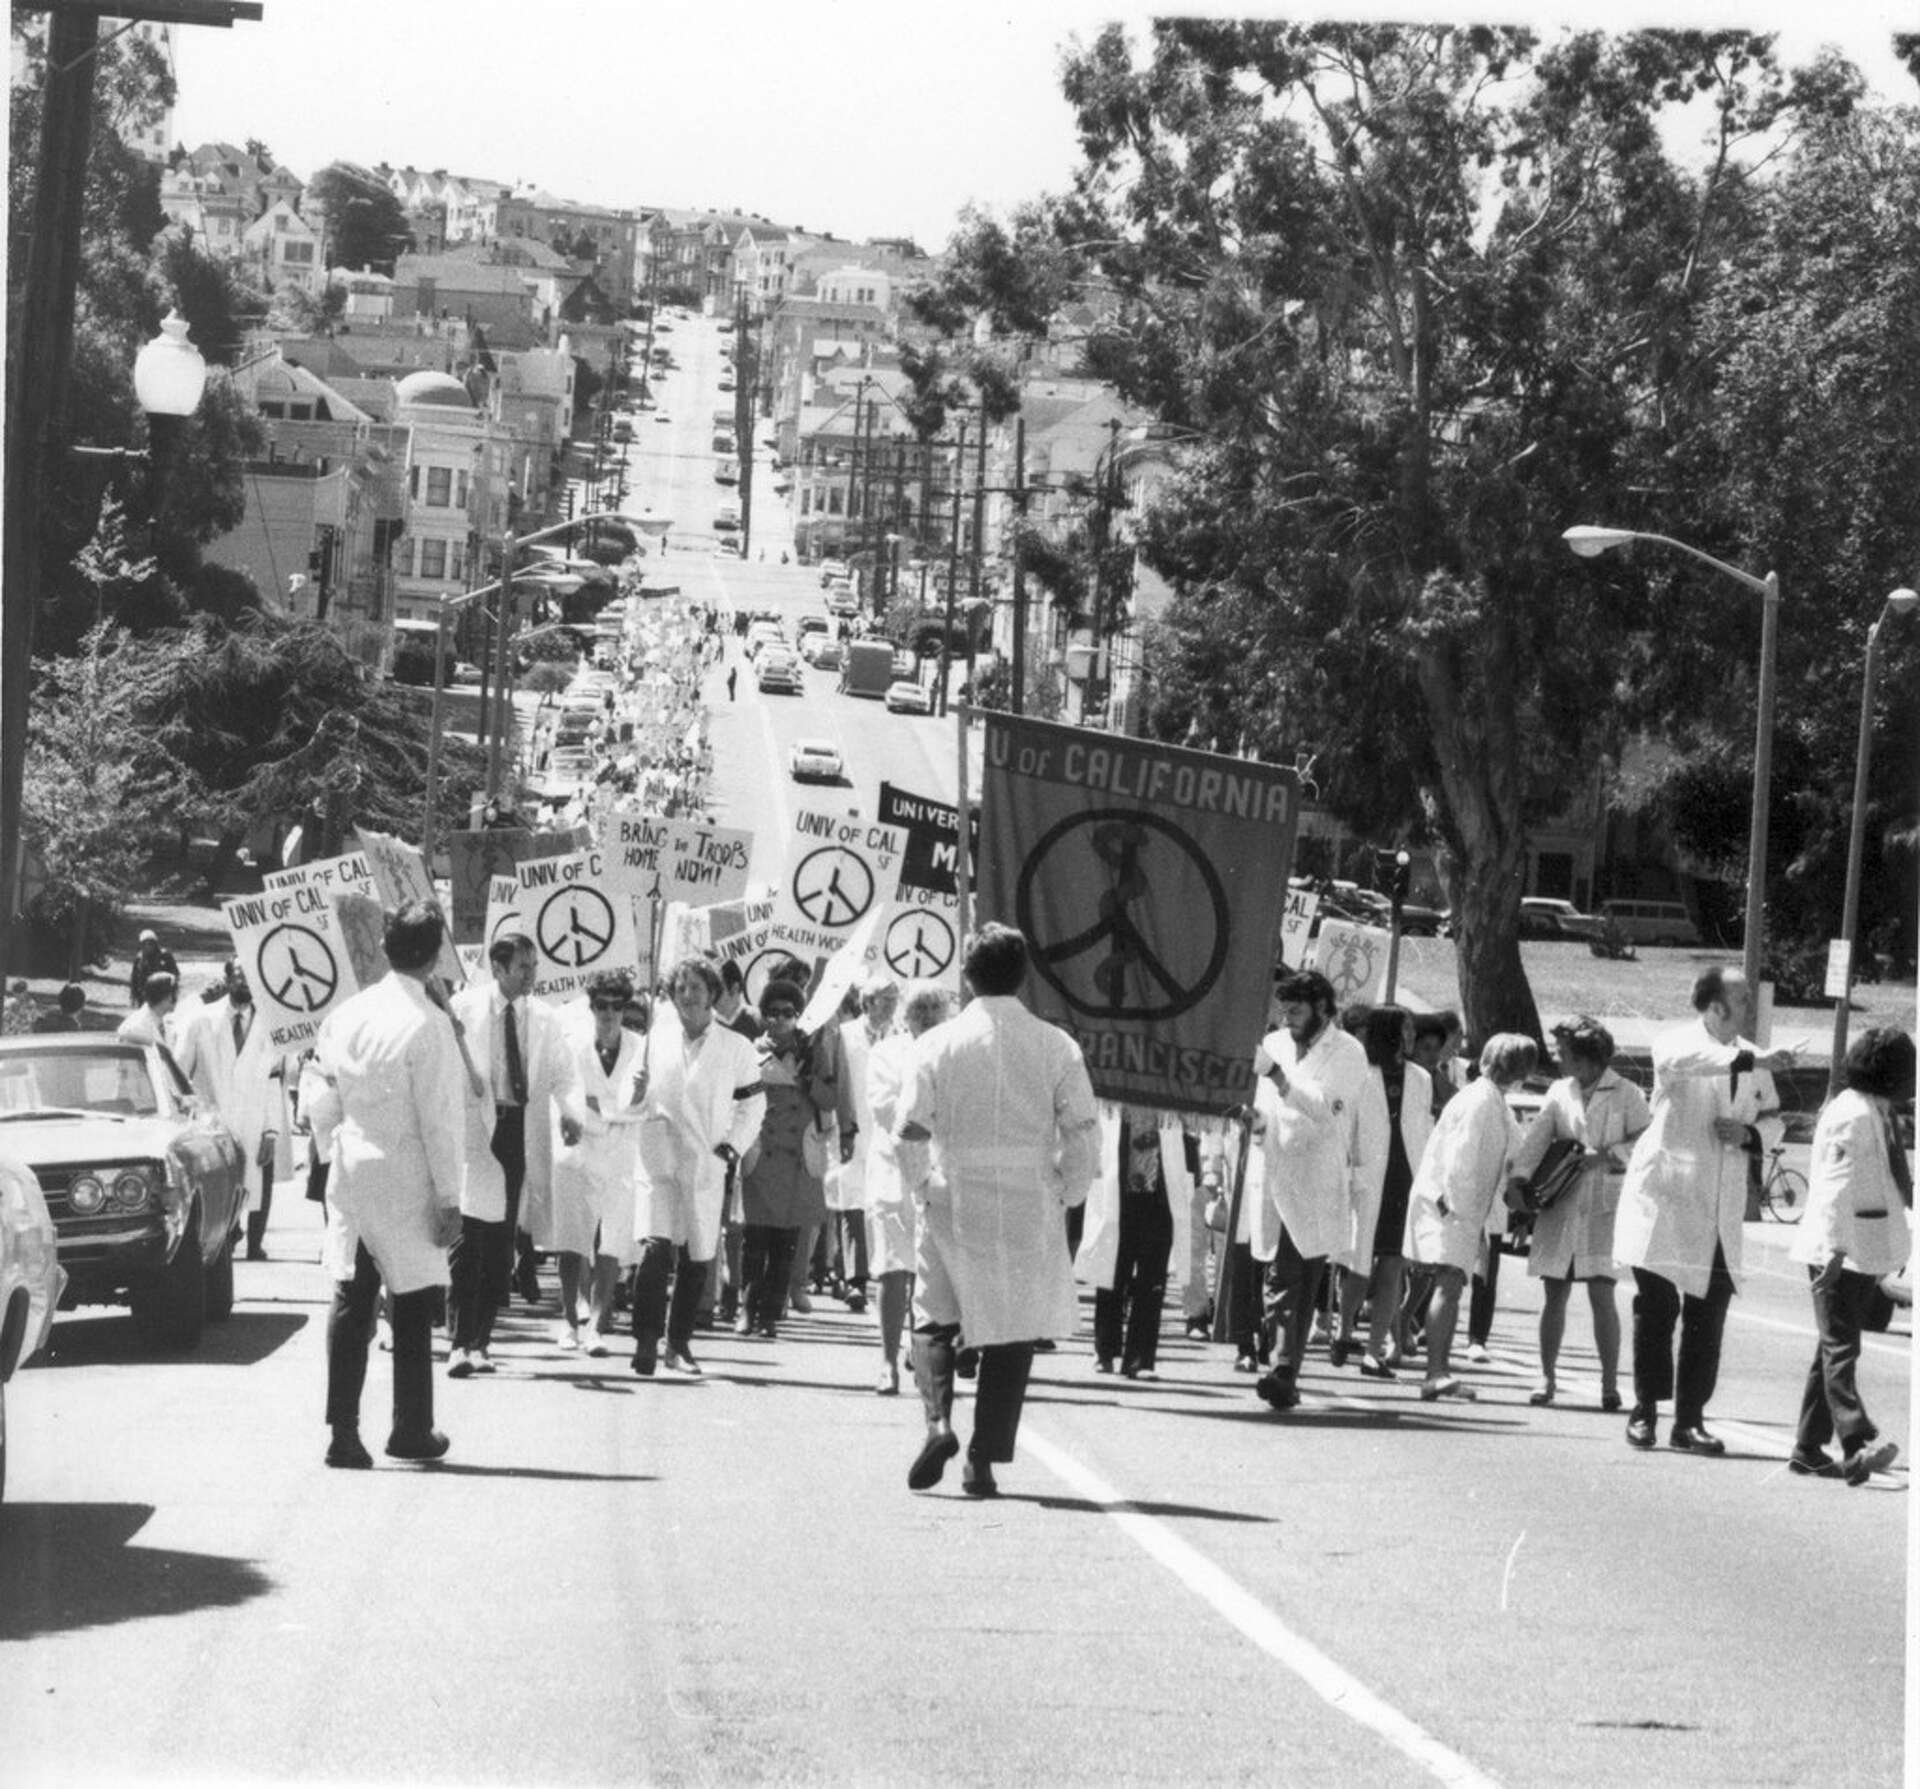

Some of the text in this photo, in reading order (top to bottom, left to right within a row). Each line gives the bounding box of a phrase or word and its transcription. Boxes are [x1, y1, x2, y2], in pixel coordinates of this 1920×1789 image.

[990, 727, 1010, 767] U
[1064, 743, 1289, 825] CALIFORNIA
[620, 820, 668, 848] BRING
[695, 830, 749, 871] TROOPS
[838, 825, 862, 844] OF
[866, 827, 900, 855] CAL
[338, 856, 374, 883] CAL
[562, 862, 584, 882] OF
[623, 848, 660, 871] HOME
[674, 859, 722, 887] NOW!
[271, 898, 293, 920] OF
[295, 887, 329, 914] CAL
[771, 923, 816, 947] HEALTH
[532, 975, 575, 997] HEALTH
[269, 1021, 315, 1046] HEALTH
[1079, 1031, 1251, 1090] RANCISCO
